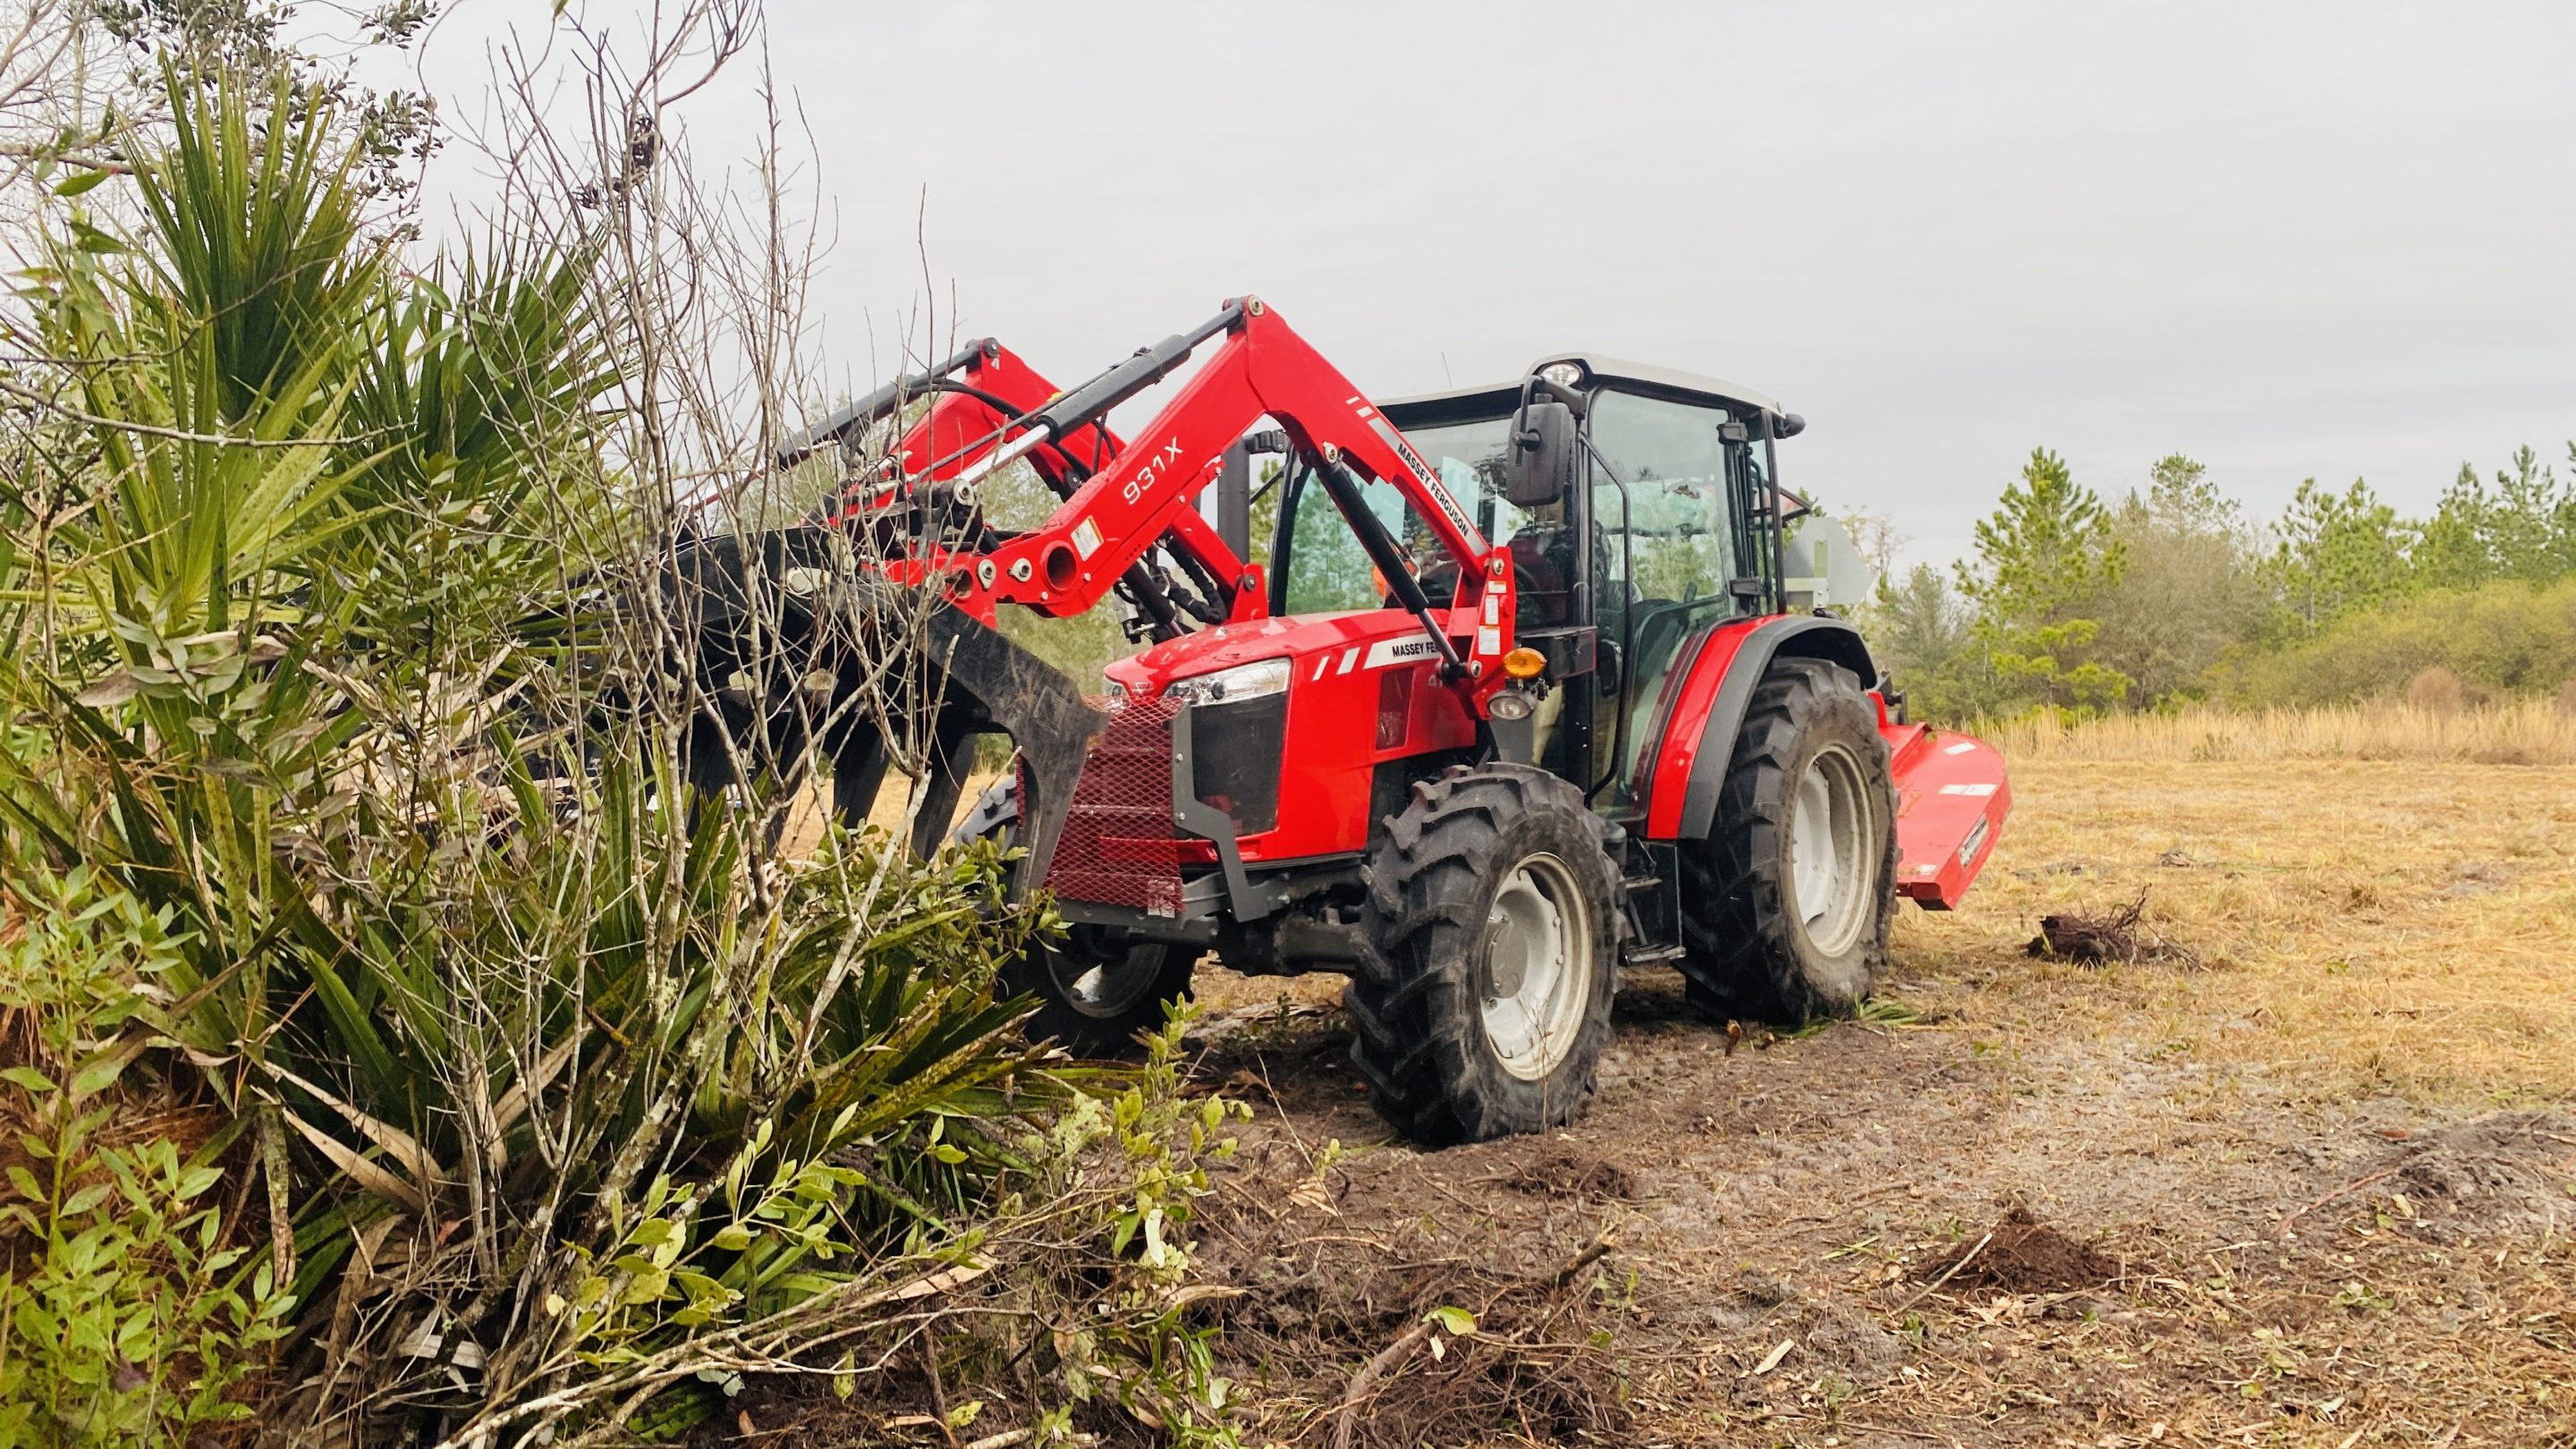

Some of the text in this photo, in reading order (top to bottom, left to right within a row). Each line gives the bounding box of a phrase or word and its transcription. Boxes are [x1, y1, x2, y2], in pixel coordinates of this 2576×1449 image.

[1123, 436, 1183, 506] 931X
[1397, 443, 1469, 537] MASSEY FERGUSON
[1392, 642, 1424, 657] MASSEY
